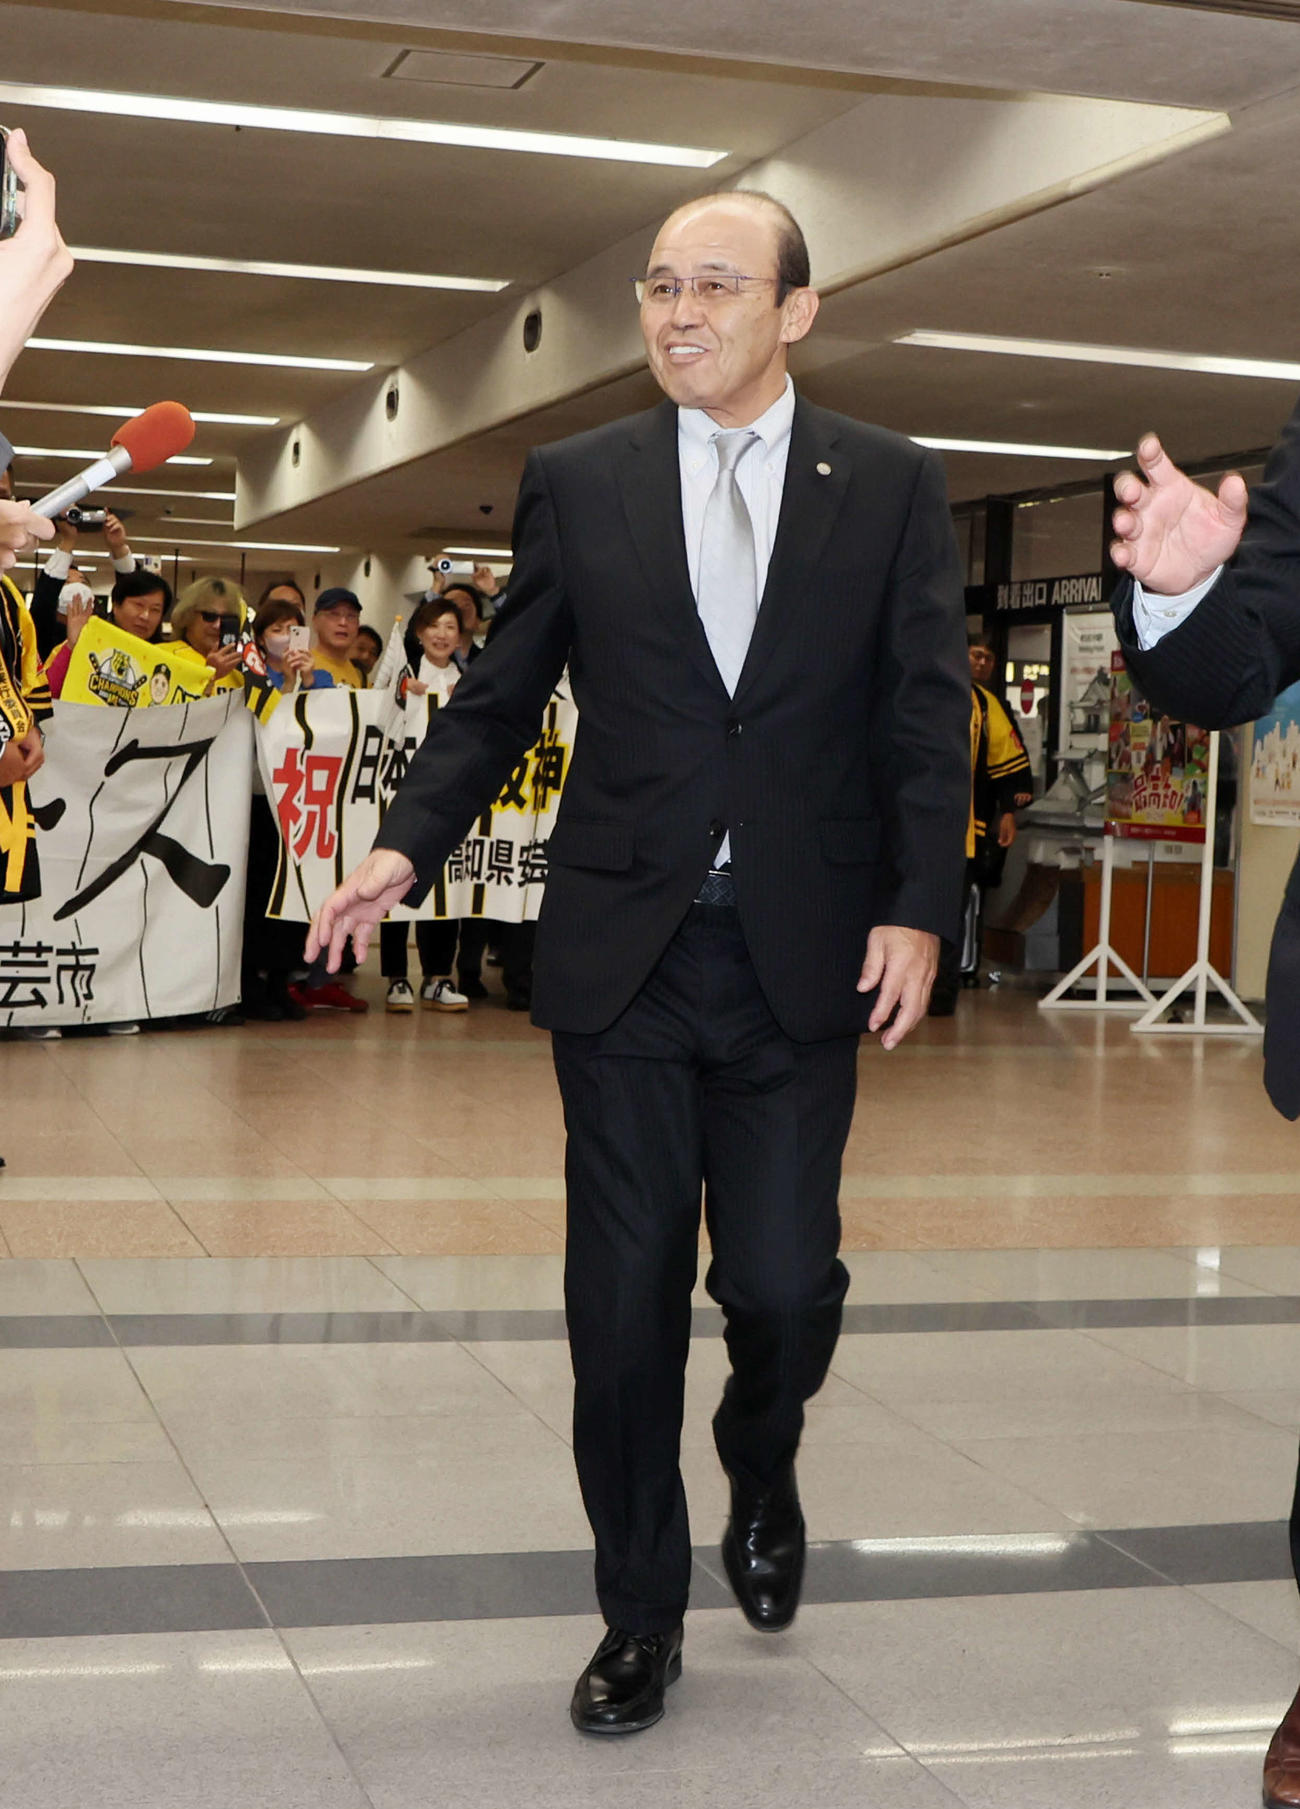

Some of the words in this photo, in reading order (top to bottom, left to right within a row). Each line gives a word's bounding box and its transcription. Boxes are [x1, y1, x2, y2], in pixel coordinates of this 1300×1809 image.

[90, 674, 137, 706] CHAMPIONS
[33, 739, 230, 921] ス
[273, 748, 342, 859] 祝
